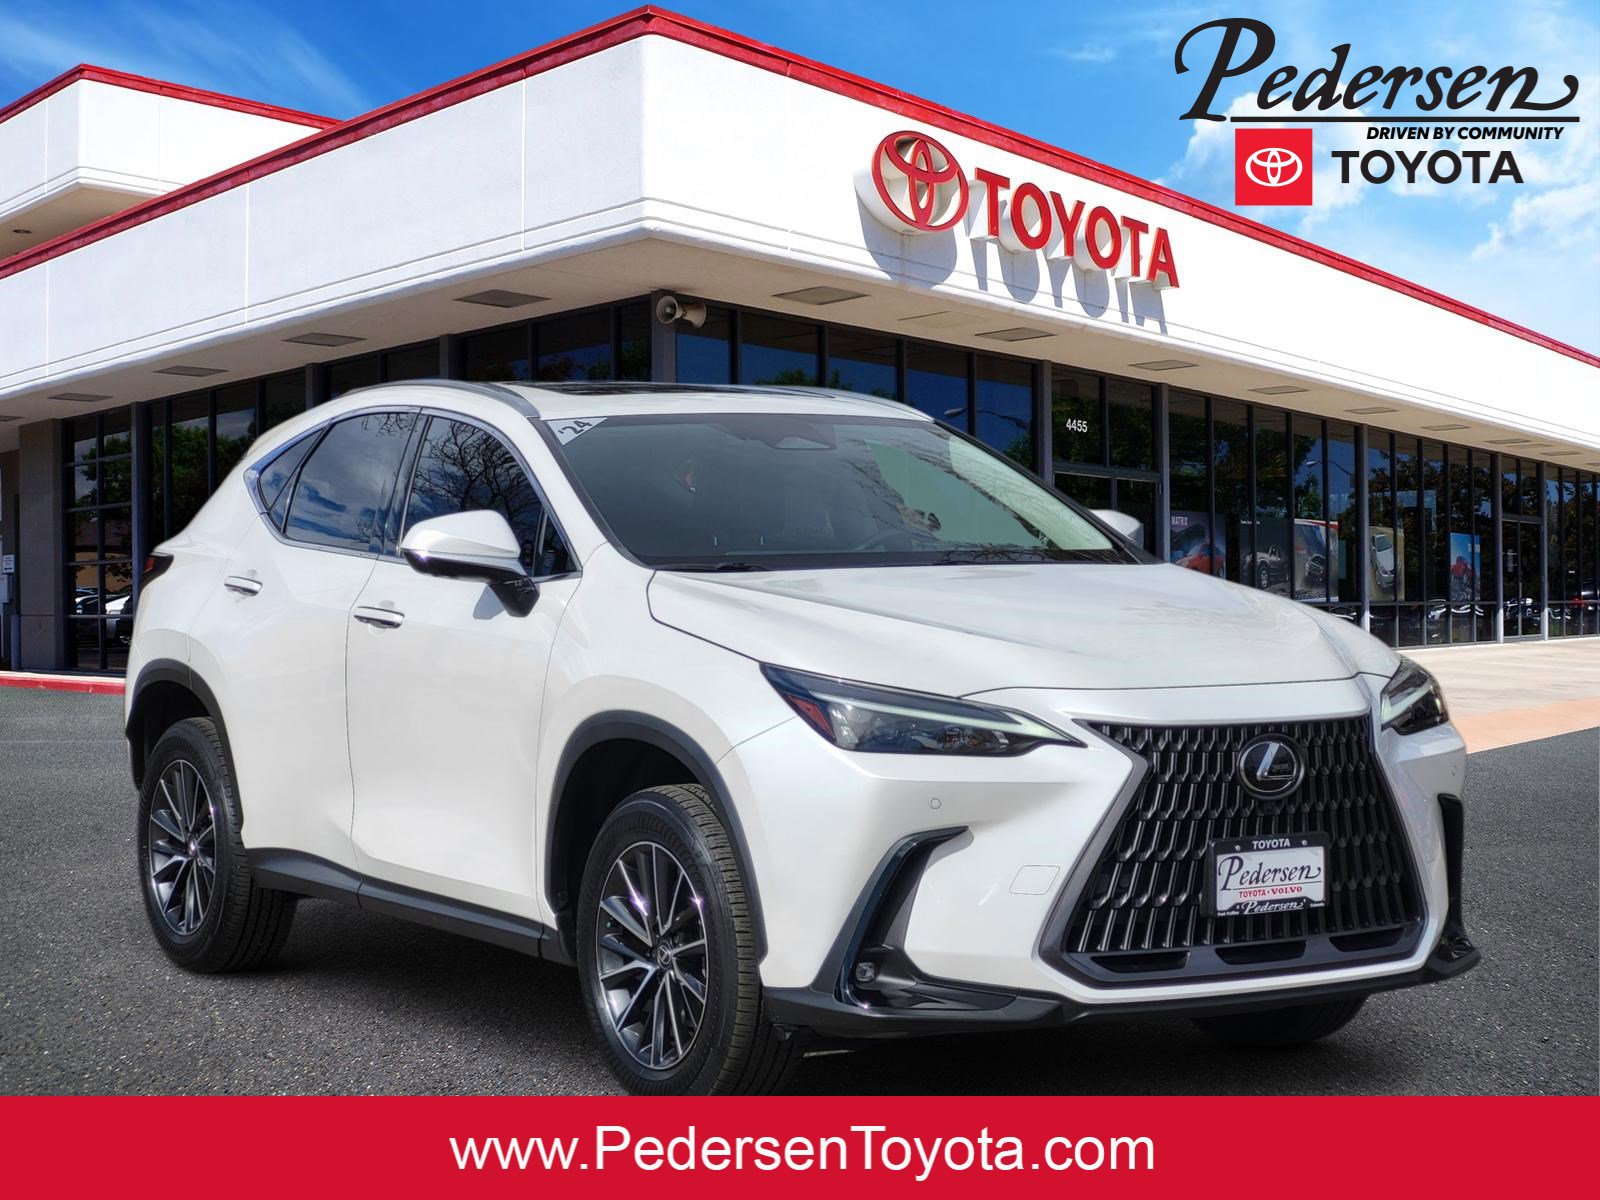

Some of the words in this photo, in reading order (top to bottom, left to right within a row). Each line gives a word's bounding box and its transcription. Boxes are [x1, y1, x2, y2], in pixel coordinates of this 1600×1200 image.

[974, 167, 1180, 288] TOYOTA
[1065, 418, 1088, 433] 4455
[1252, 838, 1291, 850] TOYOTA
[1218, 855, 1322, 891] Pedersen
[1239, 889, 1267, 898] TOYOTA
[1271, 886, 1303, 896] VOLVO
[1241, 900, 1304, 915] Pedersen
